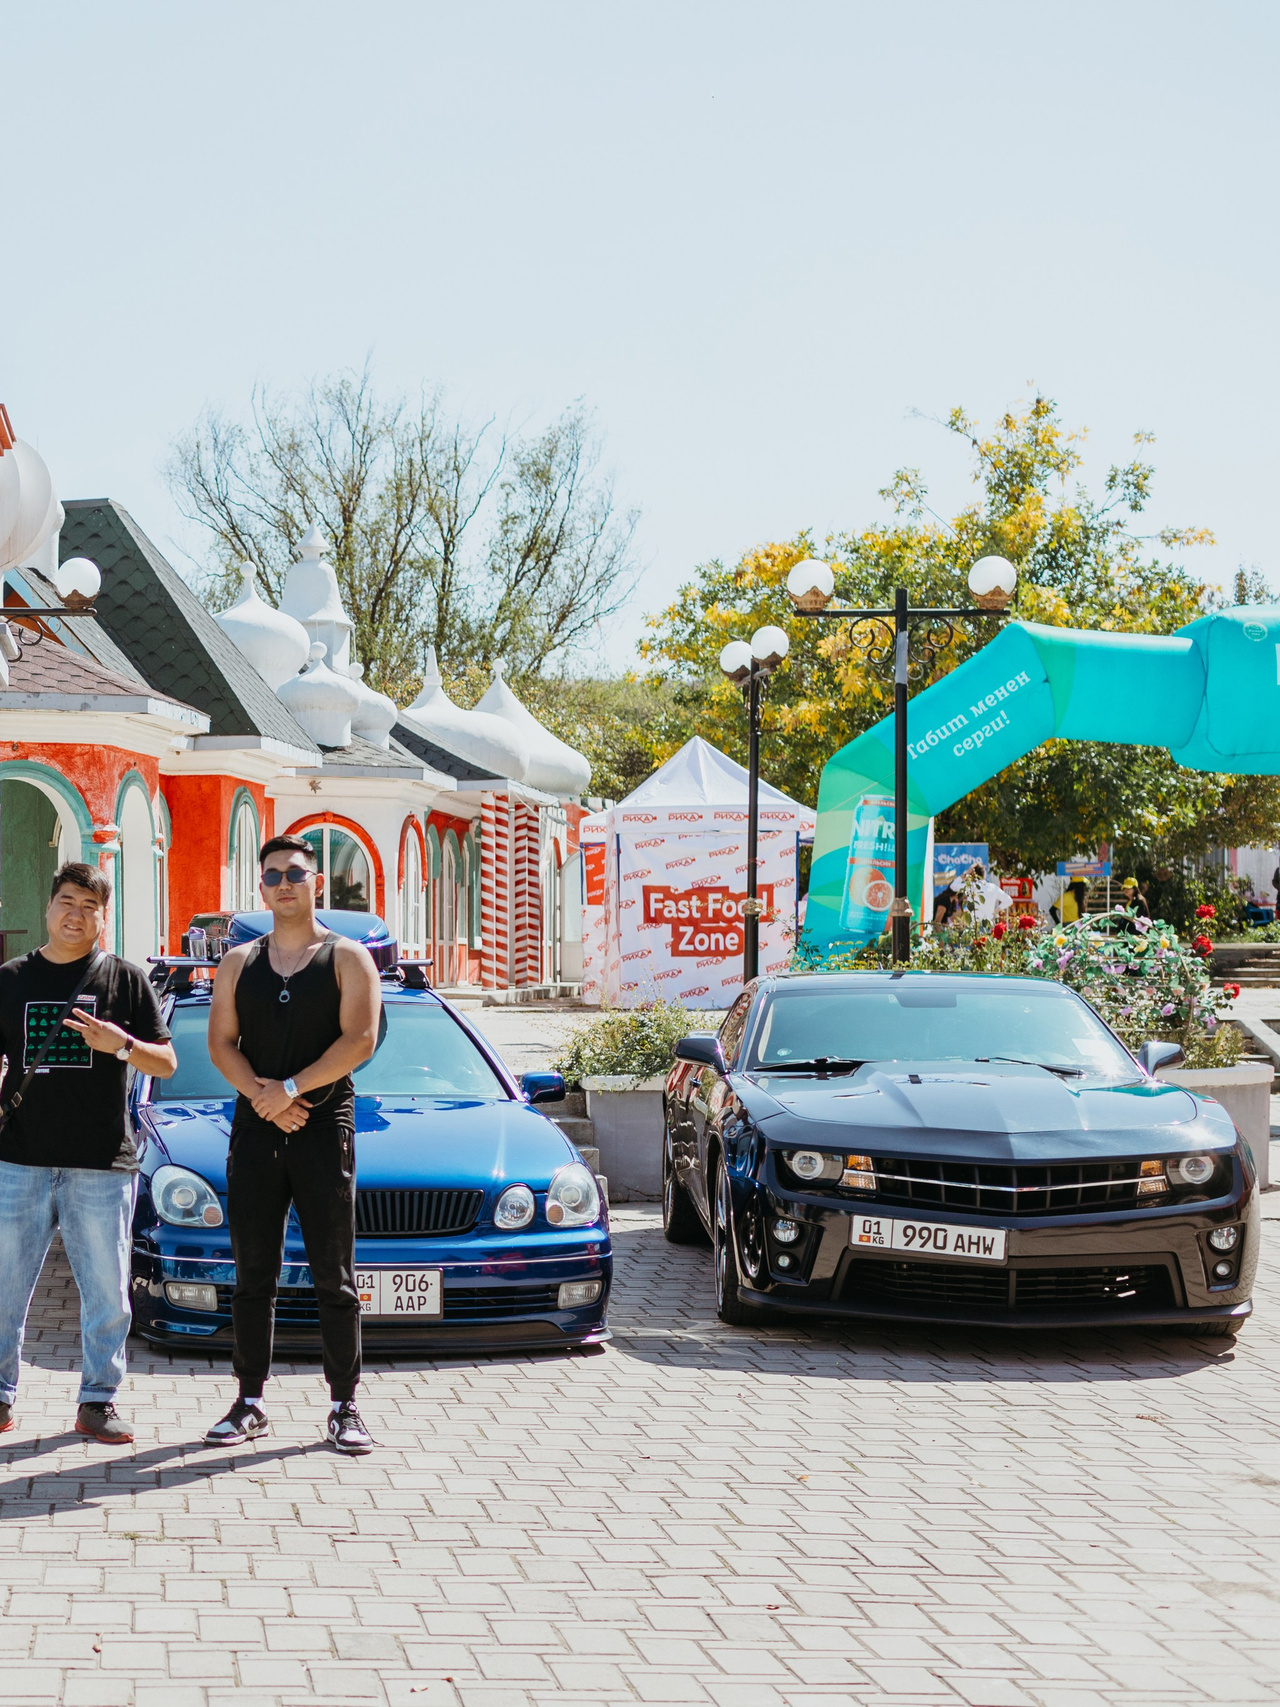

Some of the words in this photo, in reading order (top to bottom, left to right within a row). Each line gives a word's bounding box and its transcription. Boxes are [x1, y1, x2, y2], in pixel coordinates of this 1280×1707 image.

[969, 670, 1031, 718] менен
[953, 710, 1010, 757] серги!
[583, 825, 607, 833] РИХ
[851, 819, 895, 840] NITR
[780, 846, 796, 858] РИХ
[650, 892, 701, 918] Fast
[679, 926, 739, 951] Zone
[862, 1219, 882, 1235] 01
[872, 1236, 884, 1245] KG
[903, 1225, 948, 1251] 990
[953, 1233, 995, 1256] AHW
[356, 1274, 375, 1289] 01
[392, 1274, 429, 1292] 906
[394, 1296, 427, 1311] AAP
